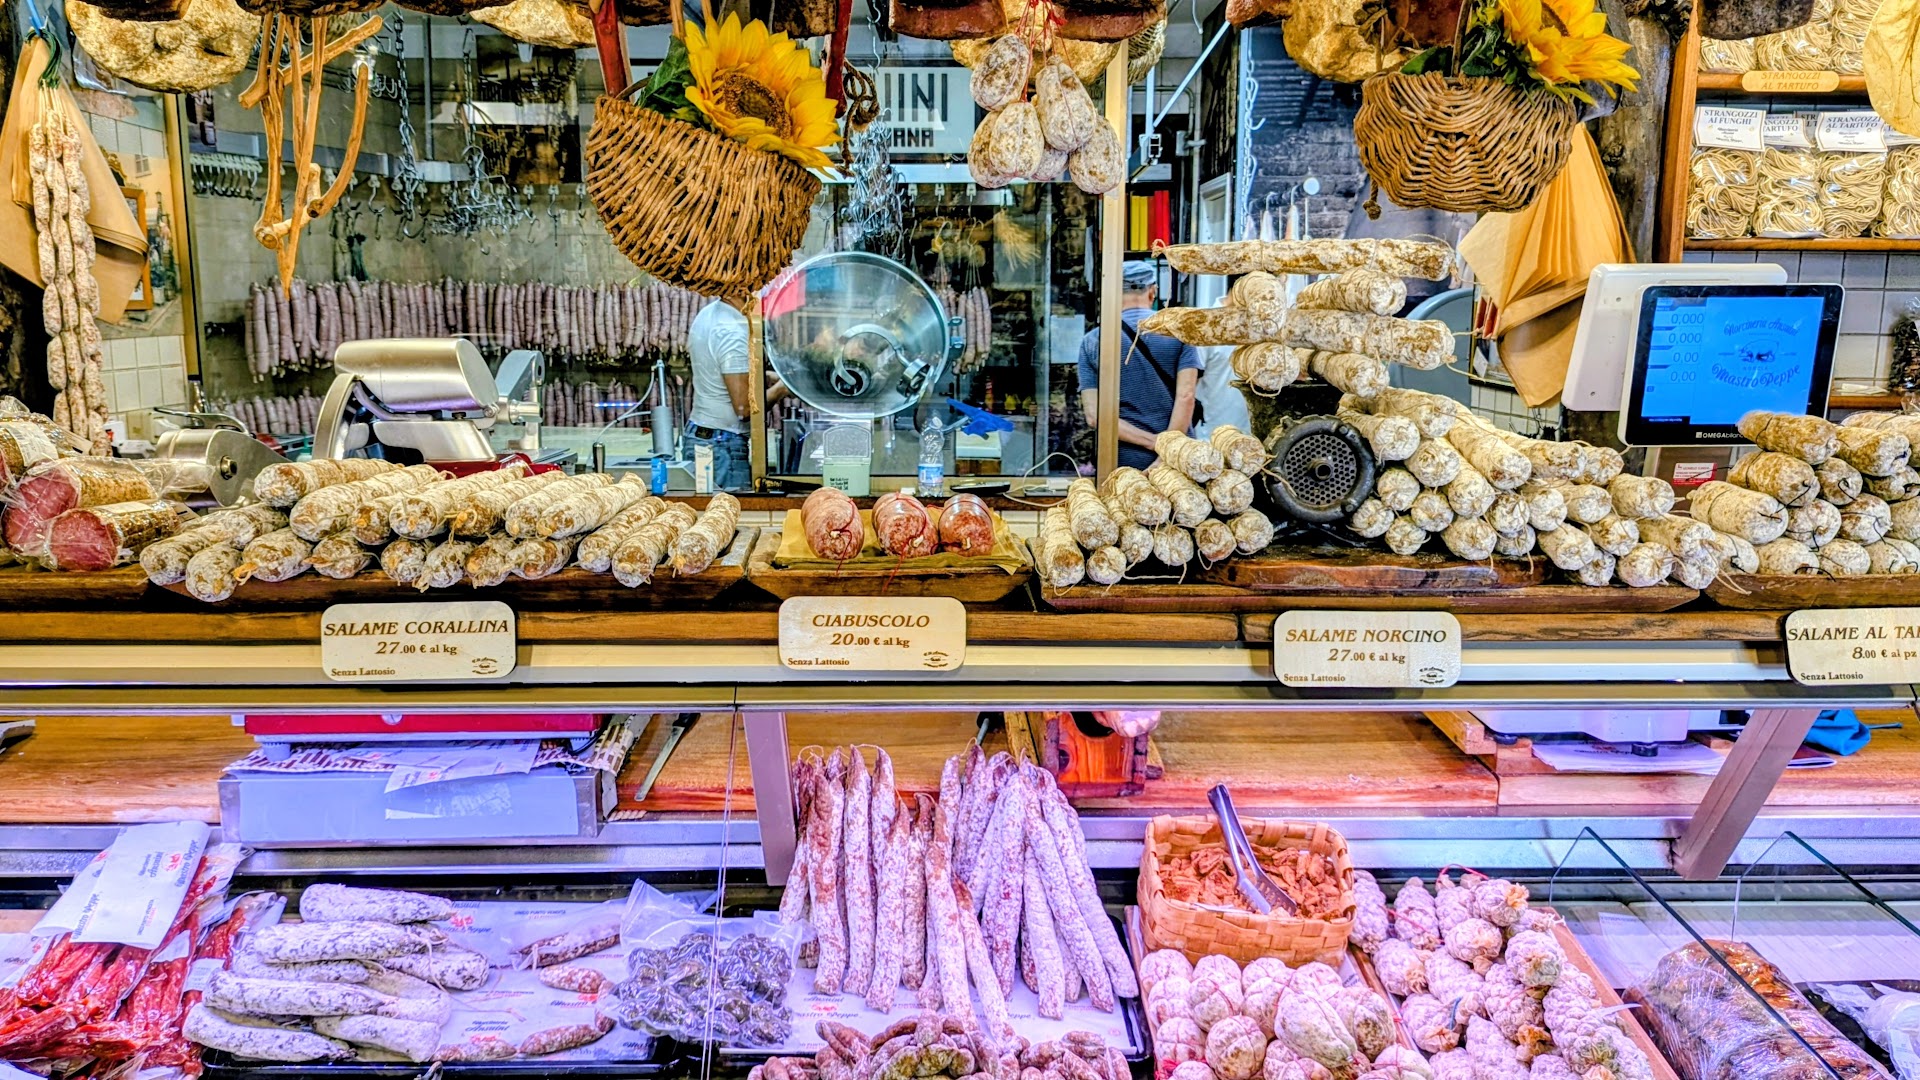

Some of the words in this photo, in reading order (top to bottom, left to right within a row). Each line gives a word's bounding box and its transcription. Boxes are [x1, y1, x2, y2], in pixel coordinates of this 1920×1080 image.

[1761, 72, 1821, 80] STRANGOZZI
[1761, 82, 1773, 90] AL
[1777, 82, 1819, 90] TARTUFO
[1704, 109, 1758, 118] STRANGOZZI
[1719, 117, 1752, 125] FUNGHI
[1671, 313, 1704, 325] 0,000
[1668, 332, 1701, 344] 0,000
[1673, 352, 1699, 363] 0,00
[1670, 371, 1696, 382] 0,00
[1711, 363, 1759, 388] Mastro
[1760, 364, 1800, 387] Peppe
[812, 614, 930, 628] CIABUSCOLO
[323, 621, 399, 637] SALAME
[404, 619, 509, 635] CORALLINA
[1787, 627, 1859, 641] SALAME
[1864, 626, 1888, 639] AL
[830, 633, 870, 646] 20.00
[873, 637, 880, 646] €
[883, 636, 893, 646] al
[895, 636, 910, 648] kg
[1285, 629, 1357, 643] SALAME
[1363, 629, 1447, 643] NORCINO
[375, 641, 416, 655] 27.00
[420, 644, 427, 654] €
[429, 643, 440, 653] al
[443, 643, 458, 656] kg
[1852, 646, 1877, 660] 8.00
[1880, 649, 1888, 658] €
[1891, 649, 1901, 658] al
[1903, 650, 1917, 660] pz
[788, 657, 813, 666] Senza
[815, 657, 850, 666] Lattosio
[1327, 648, 1366, 662] 27.00
[1369, 652, 1376, 662] €
[1378, 652, 1389, 662] al
[1391, 652, 1406, 665] kg
[331, 668, 357, 677] Senza
[359, 667, 396, 676] Lattosio
[1283, 673, 1309, 682] Senza
[1310, 673, 1346, 682] Lattosio
[1800, 672, 1826, 681] Senza
[1828, 671, 1864, 681] Lattosio
